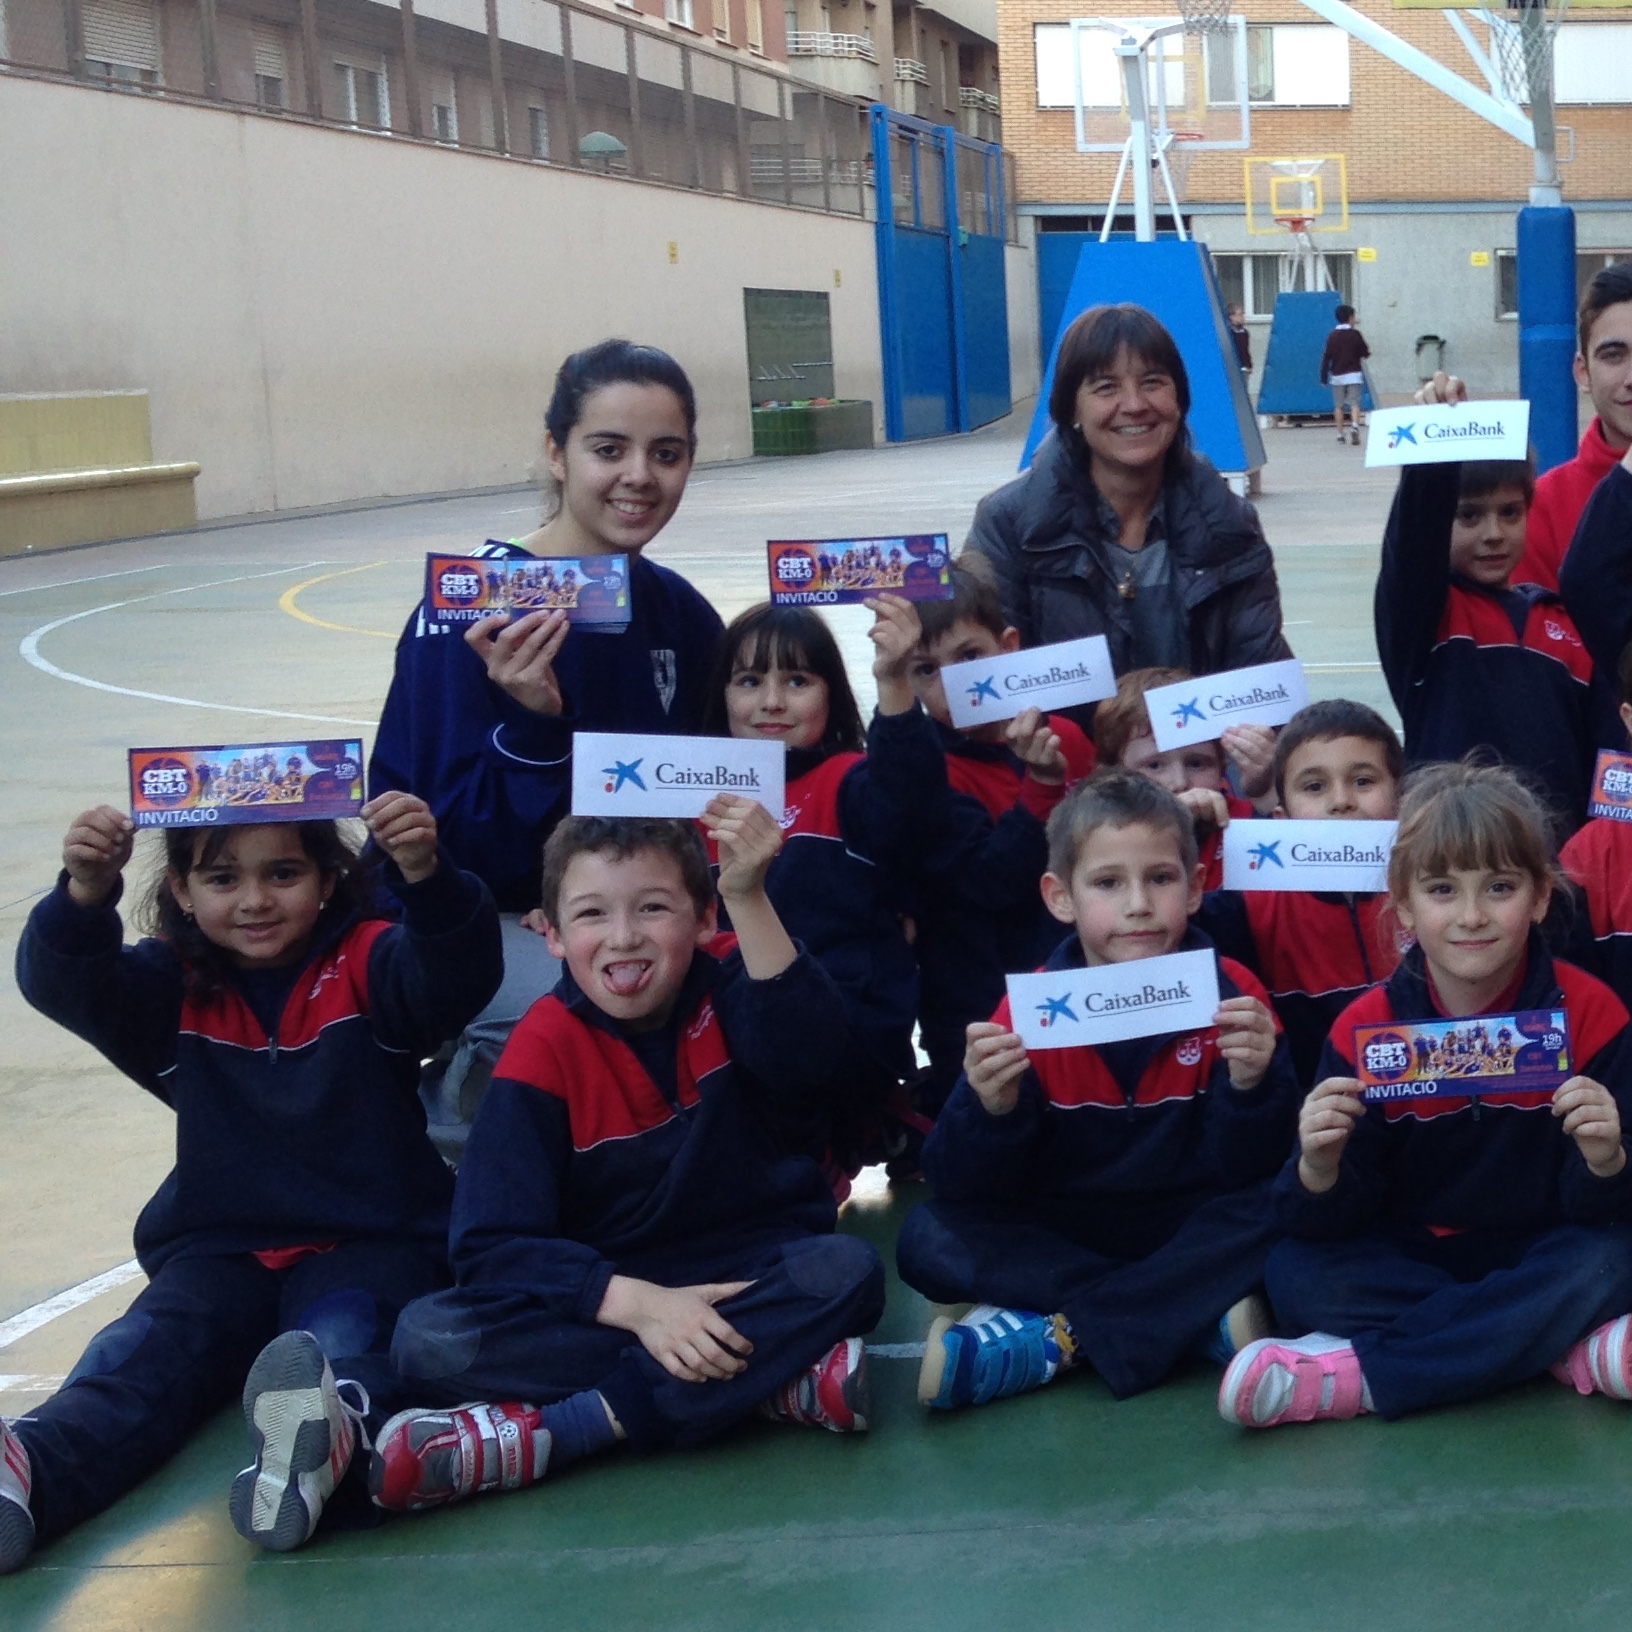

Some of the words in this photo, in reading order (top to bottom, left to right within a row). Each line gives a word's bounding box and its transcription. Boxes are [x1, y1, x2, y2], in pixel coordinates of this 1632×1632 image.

[1424, 421, 1505, 439] CaixaBank
[778, 558, 812, 569] CBT
[440, 574, 478, 585] CBT
[778, 568, 812, 579] KM-0
[441, 585, 478, 596] KM-0
[776, 589, 838, 604] INVITACIÓ
[1004, 662, 1091, 692] CaixaBank
[1208, 684, 1289, 712] CaixaBank
[142, 768, 187, 783] CBT
[655, 763, 760, 787] CaixaBank
[143, 782, 187, 795] KM-0
[138, 804, 219, 825] INVITACIÓ
[1291, 843, 1386, 862] CaixaBank
[1085, 981, 1191, 1012] CaixaBank
[1366, 1042, 1406, 1058] CBT
[1367, 1054, 1407, 1070] KM-0
[1365, 1079, 1437, 1099] INVITACIÓ
